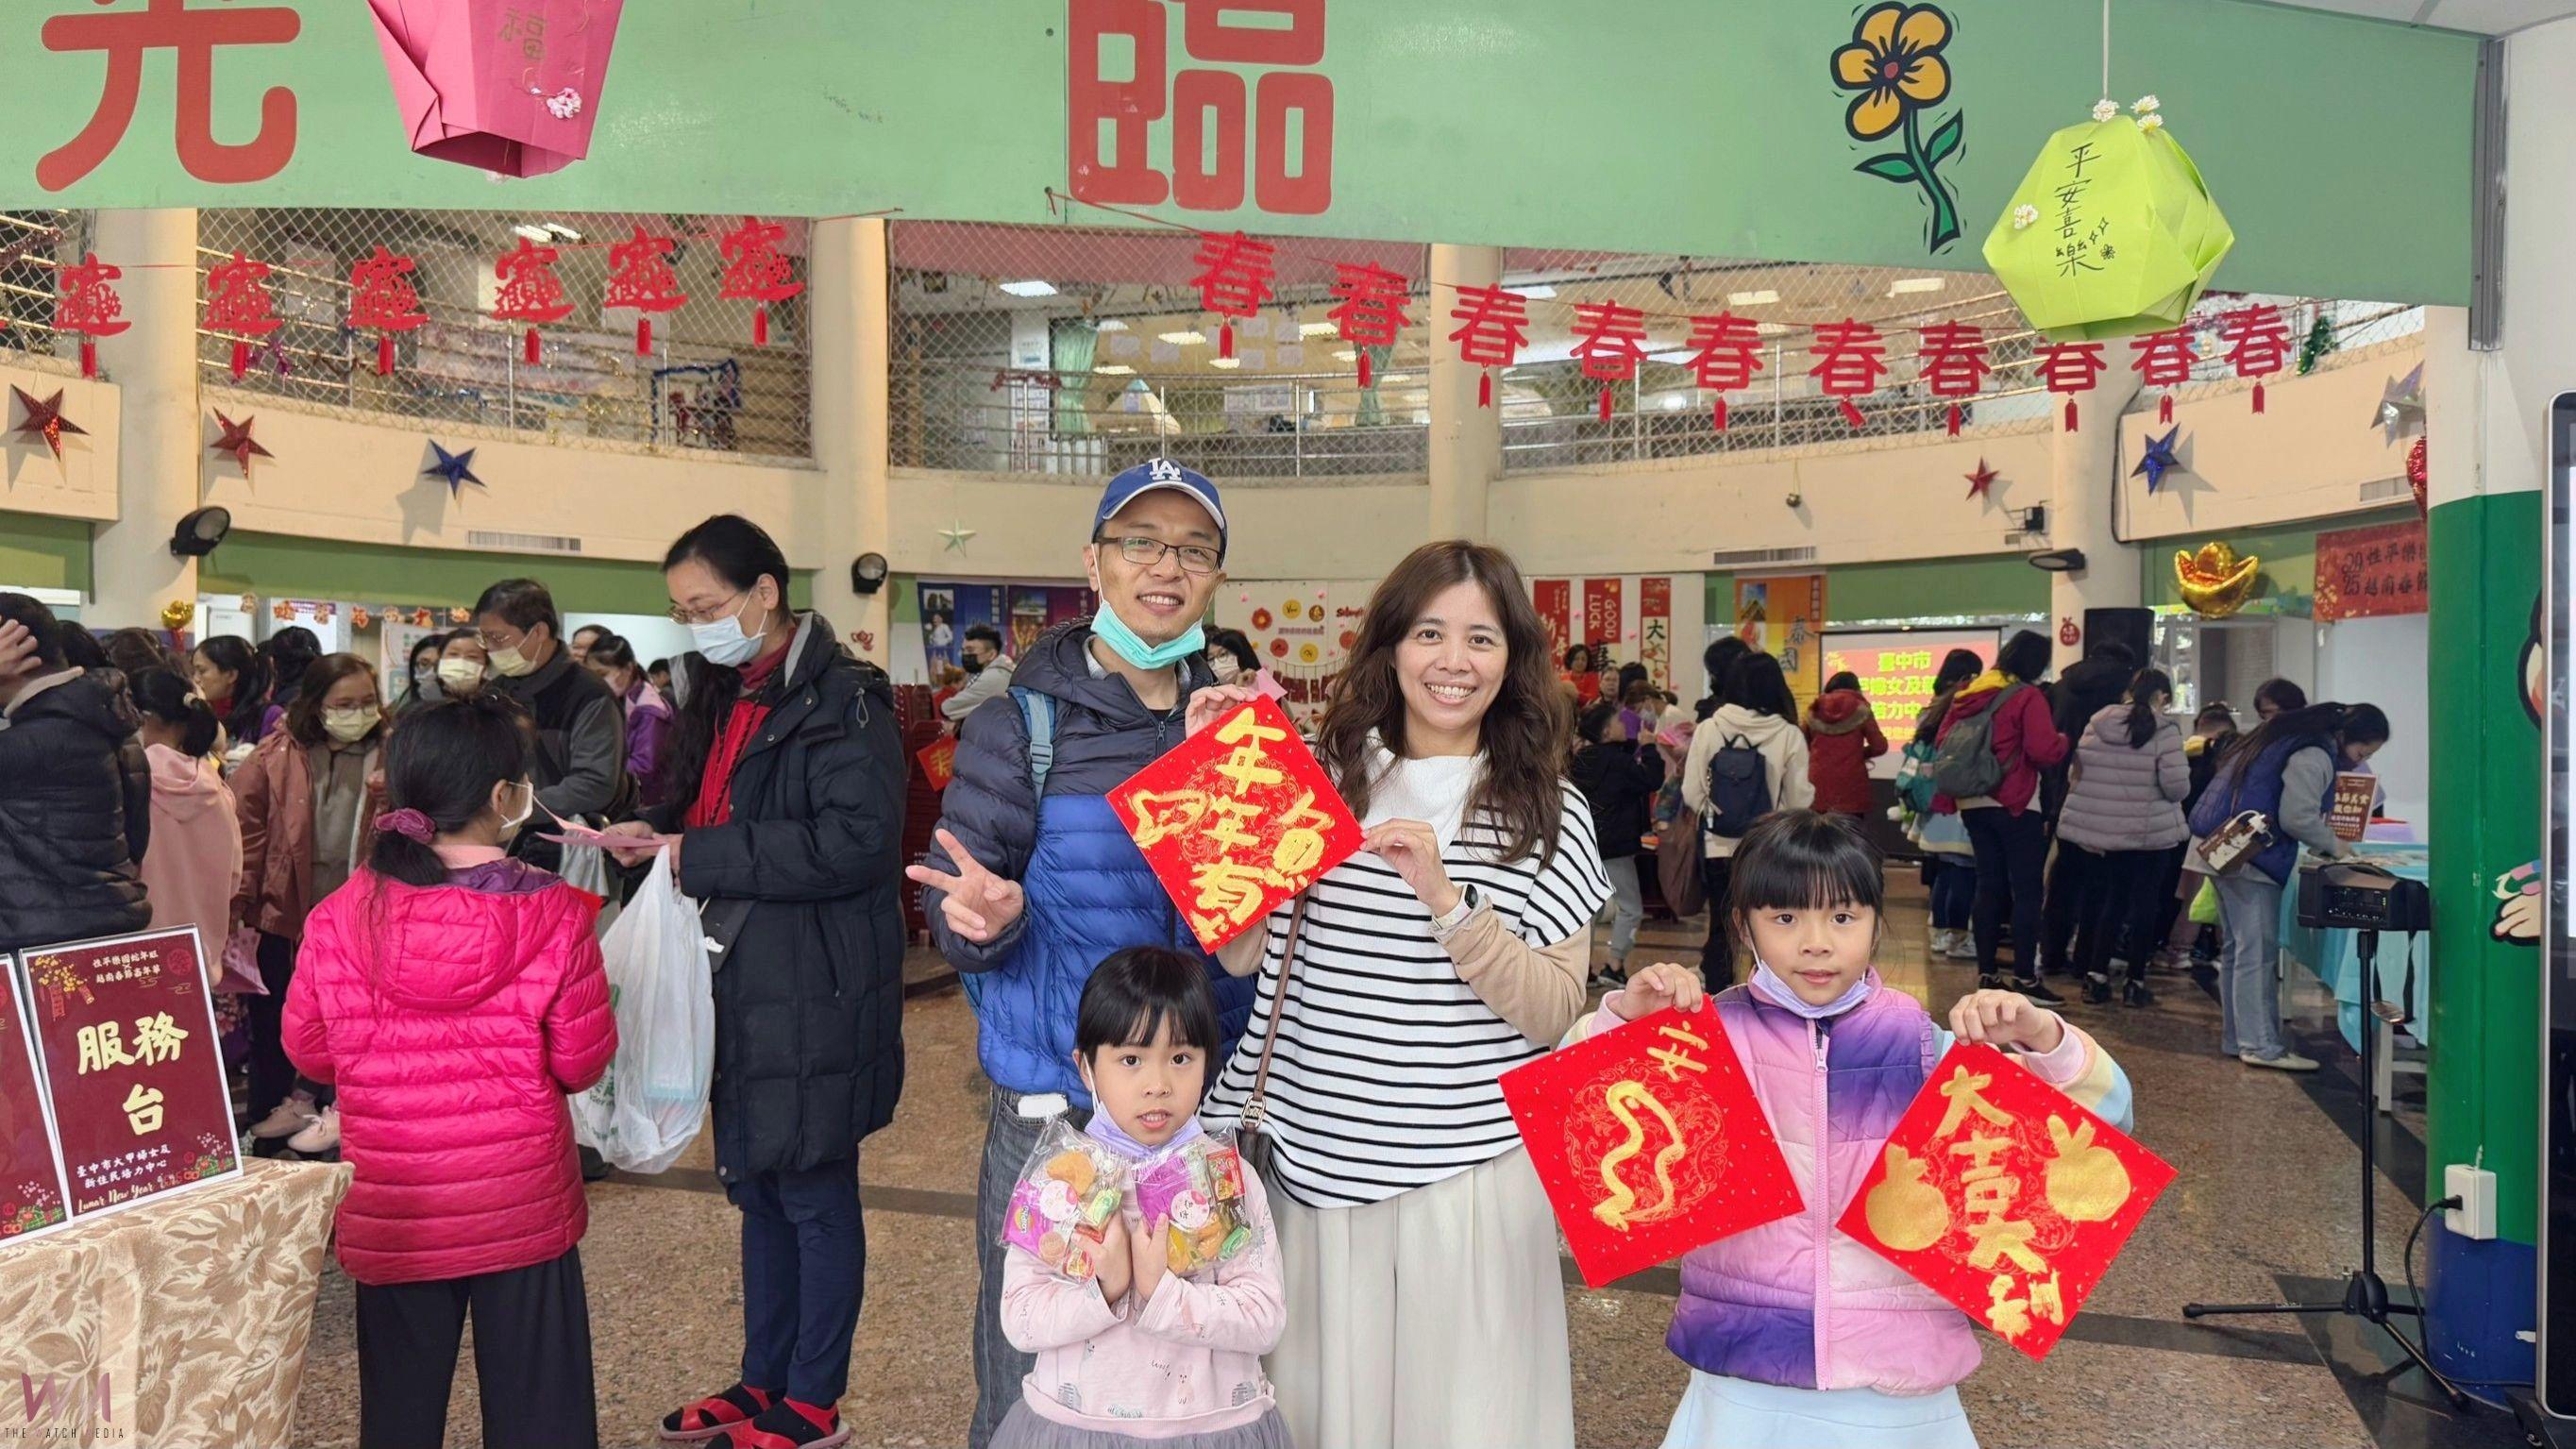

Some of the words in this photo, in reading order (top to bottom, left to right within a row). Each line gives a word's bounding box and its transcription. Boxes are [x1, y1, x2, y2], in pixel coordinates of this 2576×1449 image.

[1068, 0, 1334, 215] 臨
[2054, 142, 2105, 278] 平安喜樂
[1189, 231, 1277, 318] 春
[1327, 261, 1412, 346] 春
[1449, 284, 1529, 367] 春
[1570, 299, 1647, 382] 春
[1685, 310, 1764, 391] 春
[1809, 317, 1888, 396] 春
[1918, 319, 1992, 396] 春
[2221, 304, 2292, 379] 春
[1148, 457, 1182, 481] LA
[1589, 594, 1602, 630] LUCK
[1605, 598, 1617, 639] GOOD
[76, 1011, 189, 1075] 服務
[122, 1084, 164, 1136] 台
[76, 1143, 172, 1178] 臺中市大甲婦女及
[77, 1195, 107, 1214] Lunar
[109, 1188, 129, 1204] New
[131, 1182, 154, 1200] Year
[85, 1159, 167, 1189] 新住民培力中心
